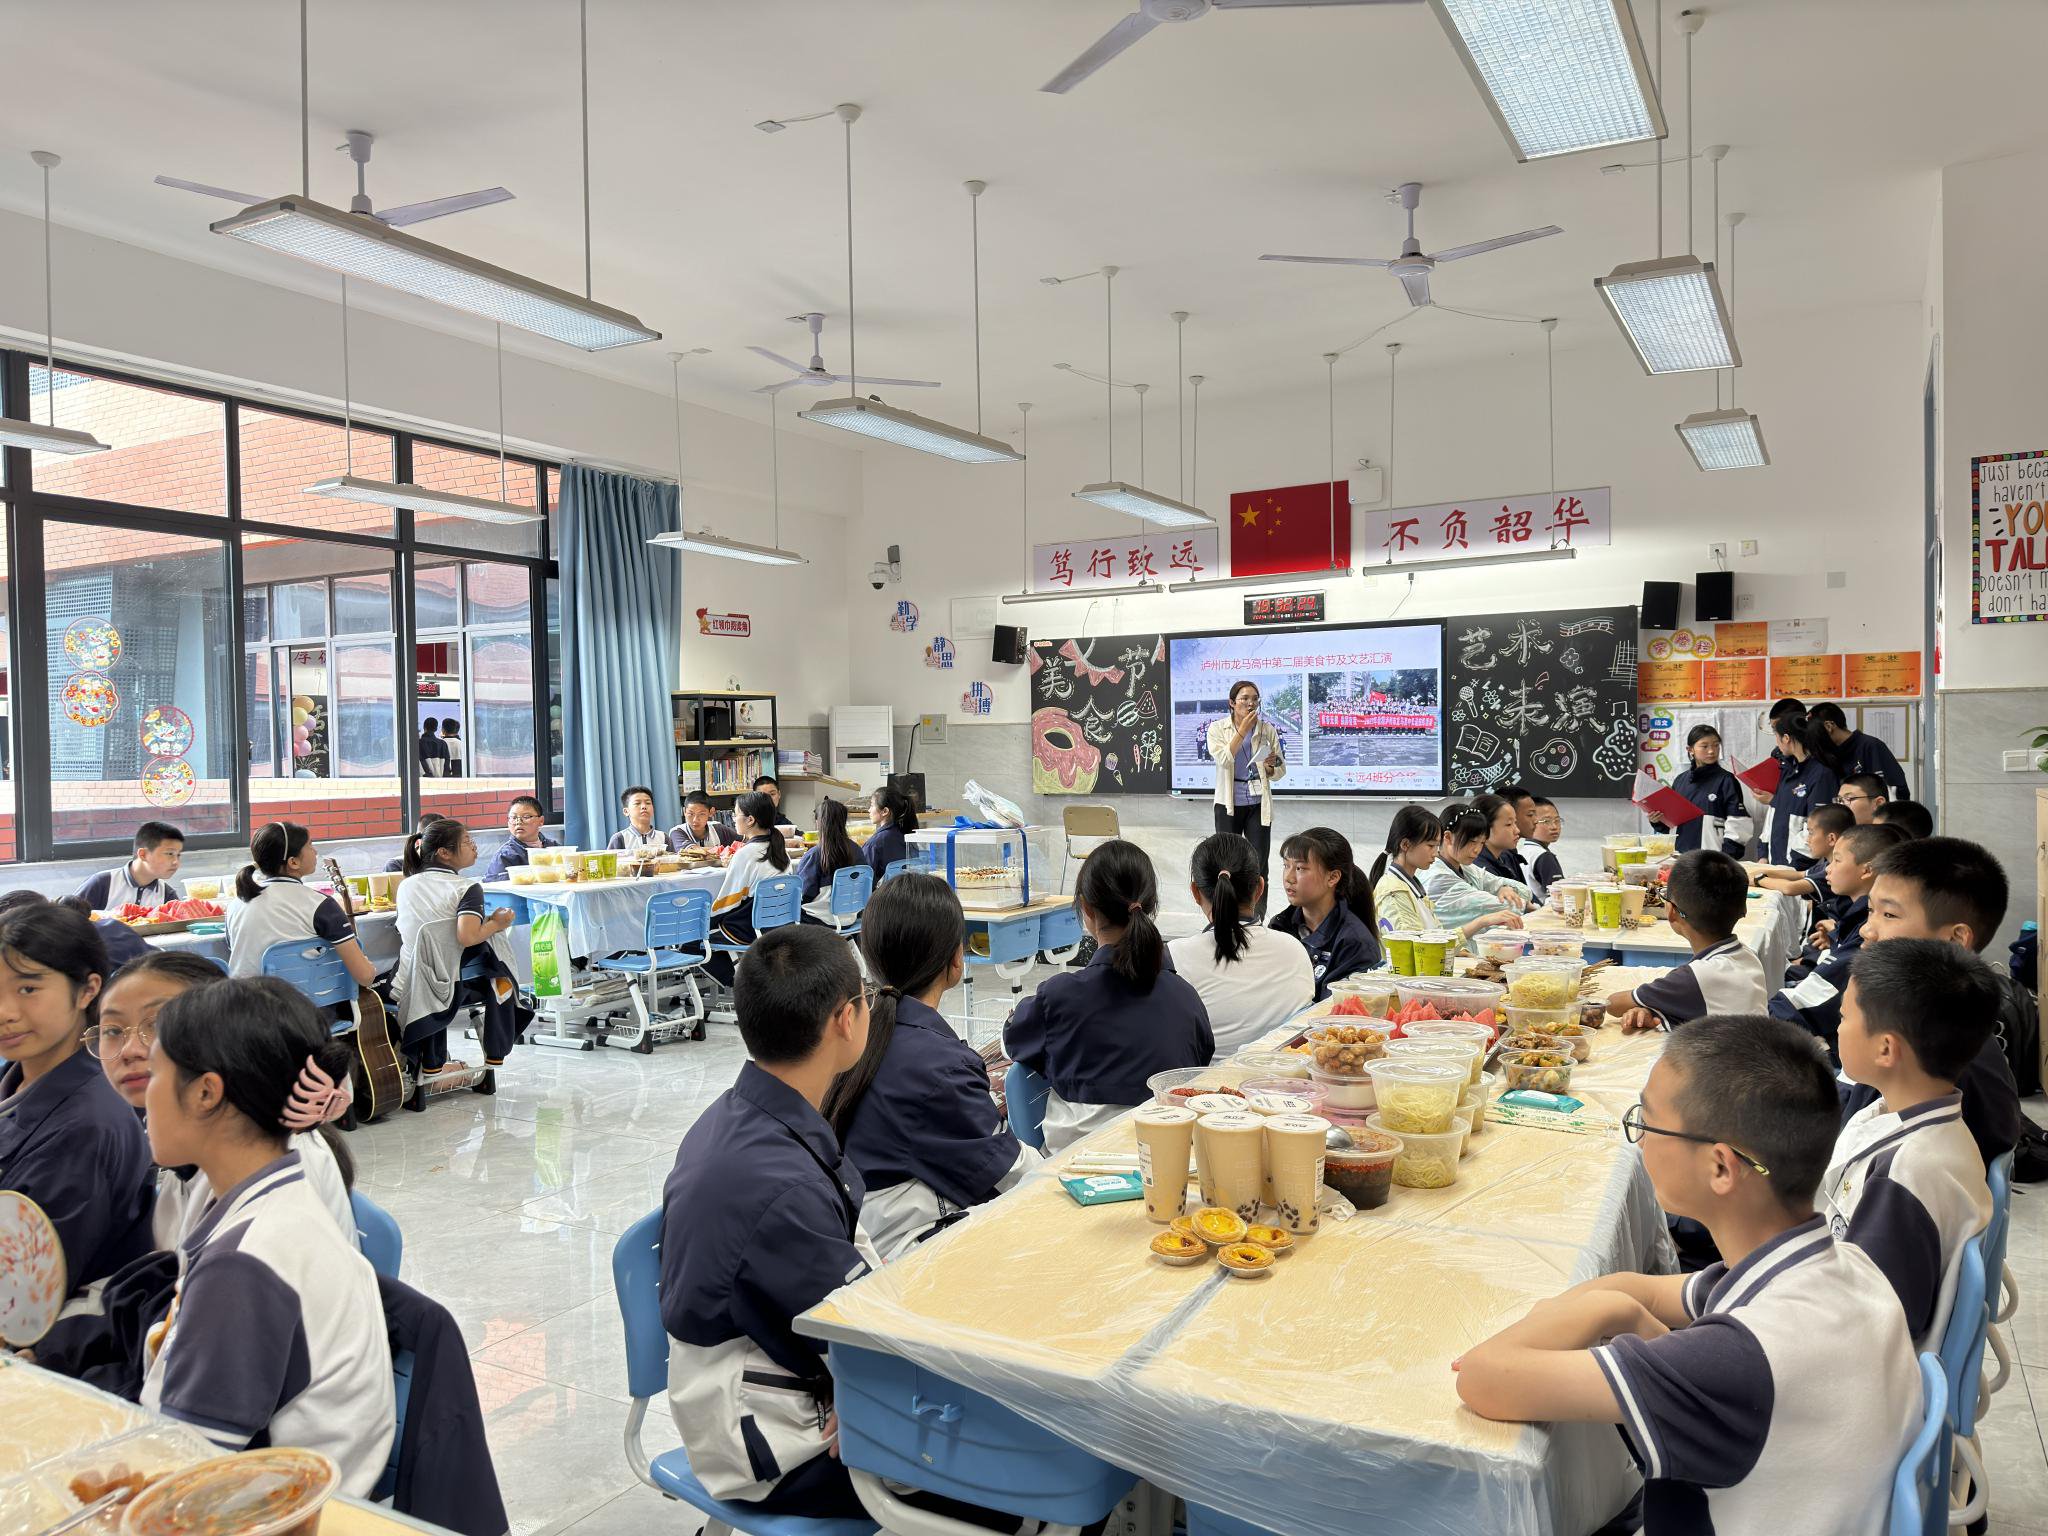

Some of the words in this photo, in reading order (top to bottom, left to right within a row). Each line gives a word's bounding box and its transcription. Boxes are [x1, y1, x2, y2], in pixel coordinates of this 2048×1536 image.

[1981, 464, 2010, 484] Just
[1993, 482, 2046, 503] haven't
[1382, 496, 1590, 551] 不负韶华
[2005, 500, 2048, 537] YO
[1050, 540, 1205, 587] 笃行致远
[1985, 536, 2048, 573] TAL
[1988, 594, 2023, 613] don't
[933, 636, 953, 668] 静思
[971, 681, 991, 713] 拼搏
